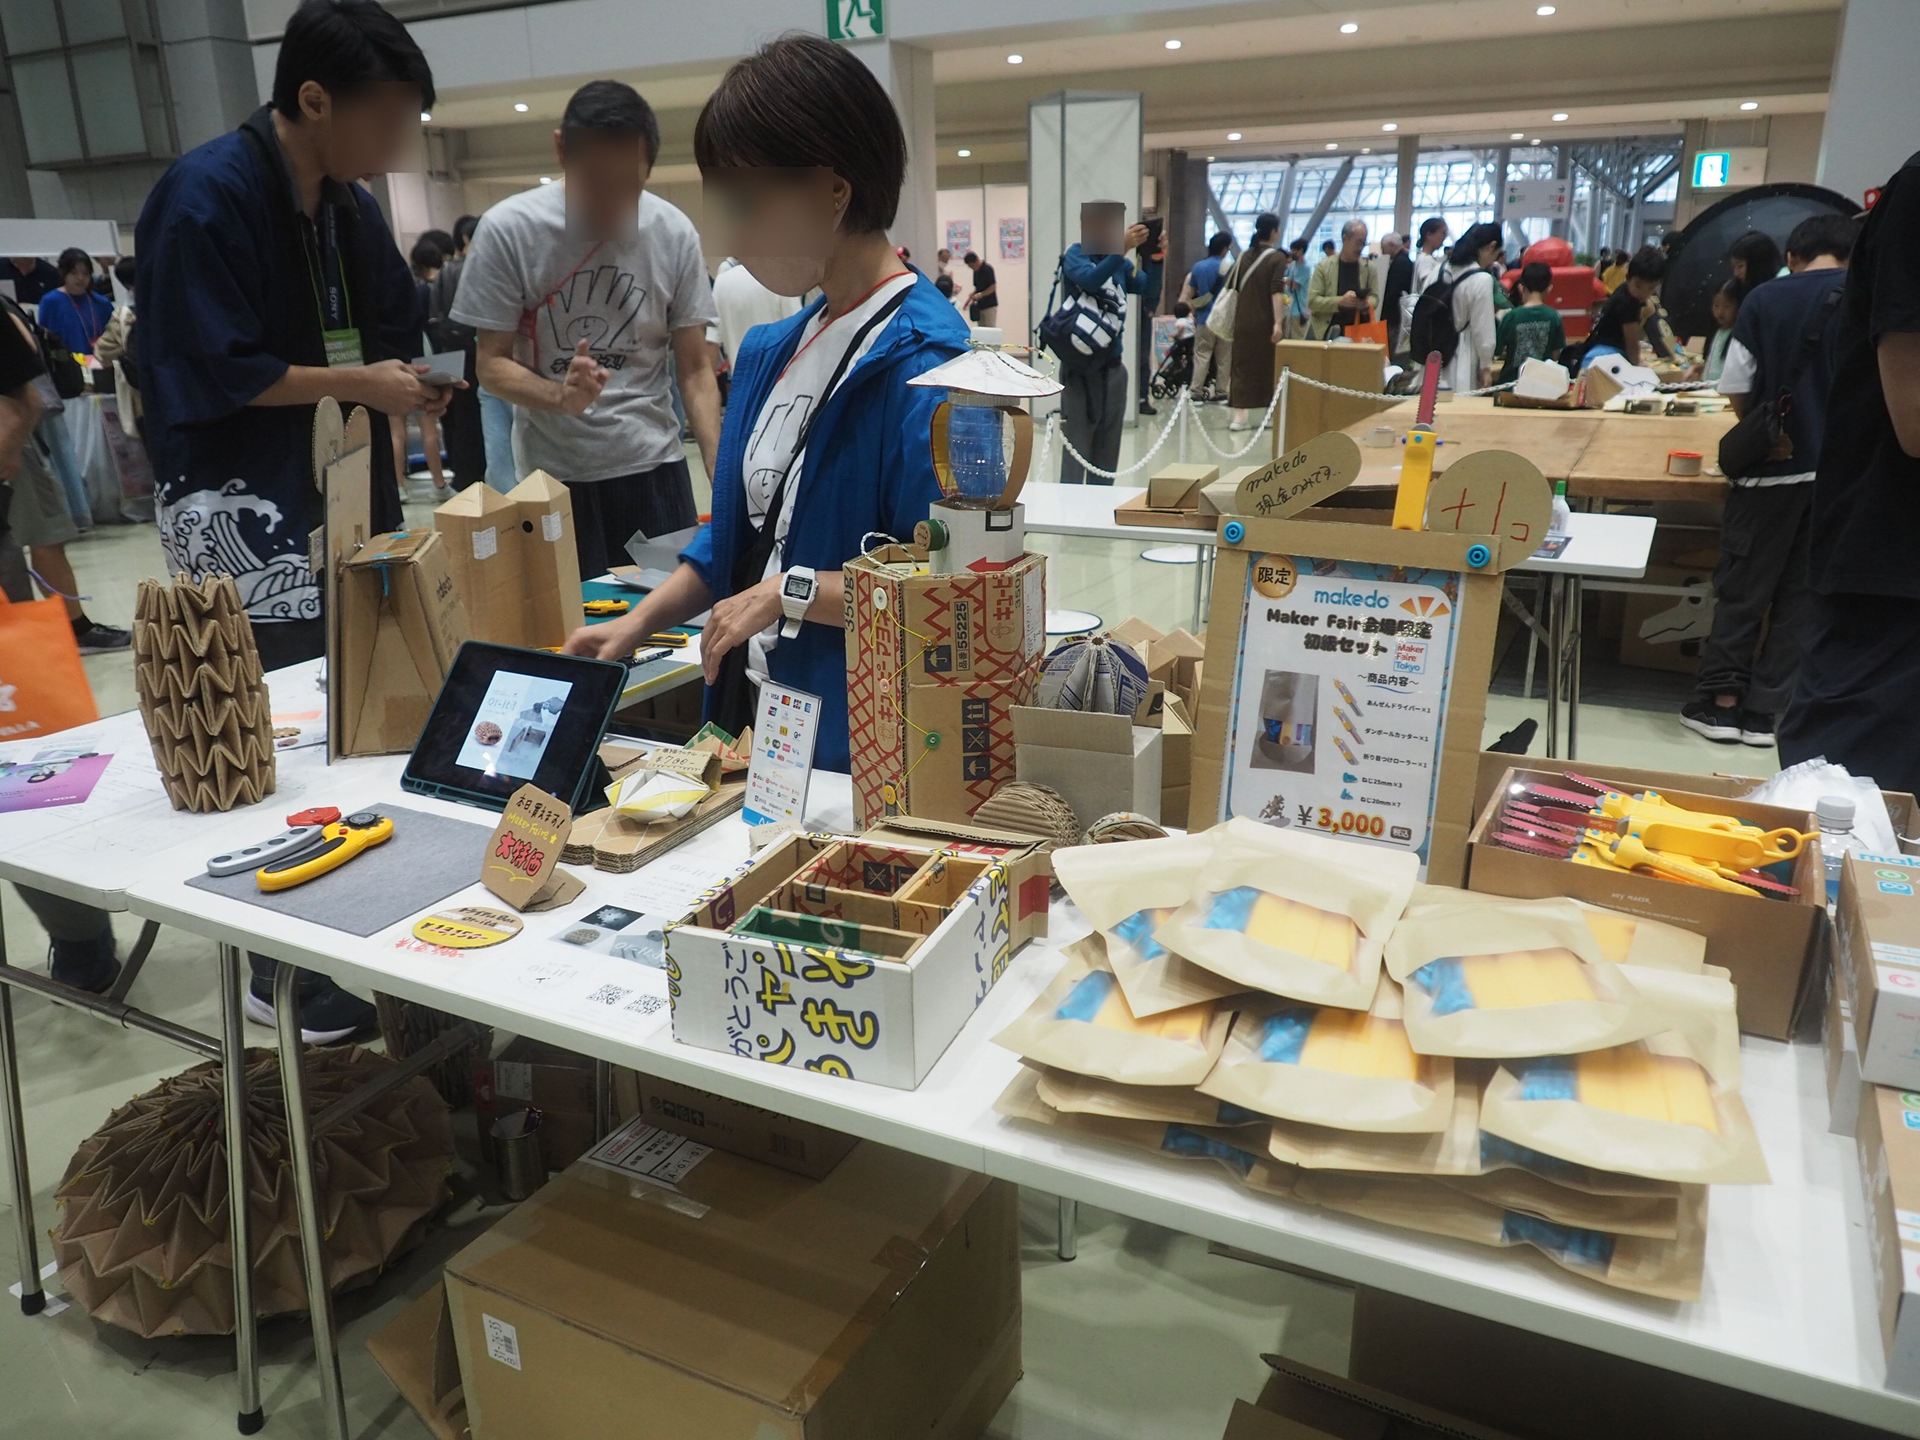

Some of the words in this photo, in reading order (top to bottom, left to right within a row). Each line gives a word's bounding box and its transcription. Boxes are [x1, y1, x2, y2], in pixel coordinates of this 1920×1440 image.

[328, 286, 338, 320] SONY
[1257, 566, 1291, 586] 限定
[1314, 587, 1389, 609] makedo
[957, 602, 968, 650] 55225
[1266, 608, 1319, 626] Maker
[1304, 633, 1388, 656] 初級セット
[1398, 644, 1424, 654] Maker
[1395, 661, 1421, 673] Tokyo
[1396, 653, 1417, 662] Faire
[496, 830, 544, 877] 大特価
